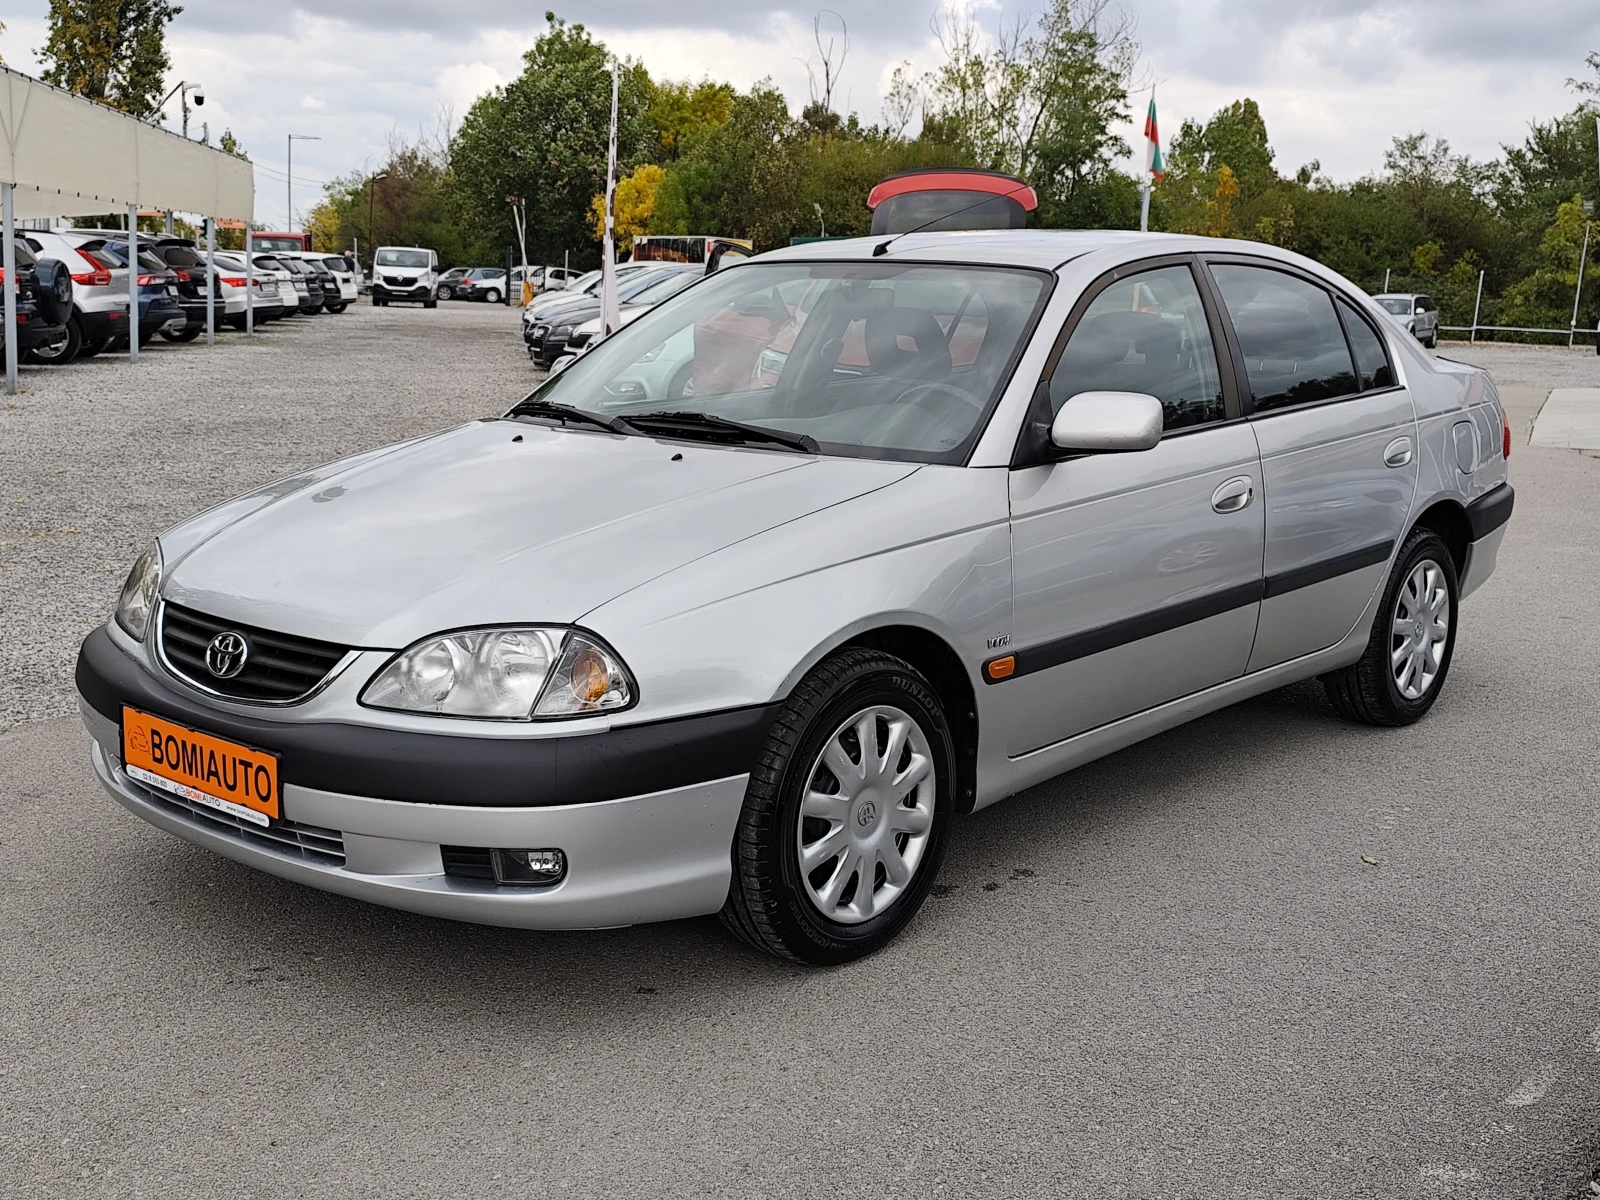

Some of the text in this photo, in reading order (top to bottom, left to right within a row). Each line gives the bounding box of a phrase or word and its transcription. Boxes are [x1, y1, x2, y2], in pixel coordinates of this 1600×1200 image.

[890, 676, 940, 717] DUNLOP
[151, 728, 271, 803] BOMIAUTO
[226, 804, 266, 823] www.bomiauto.com
